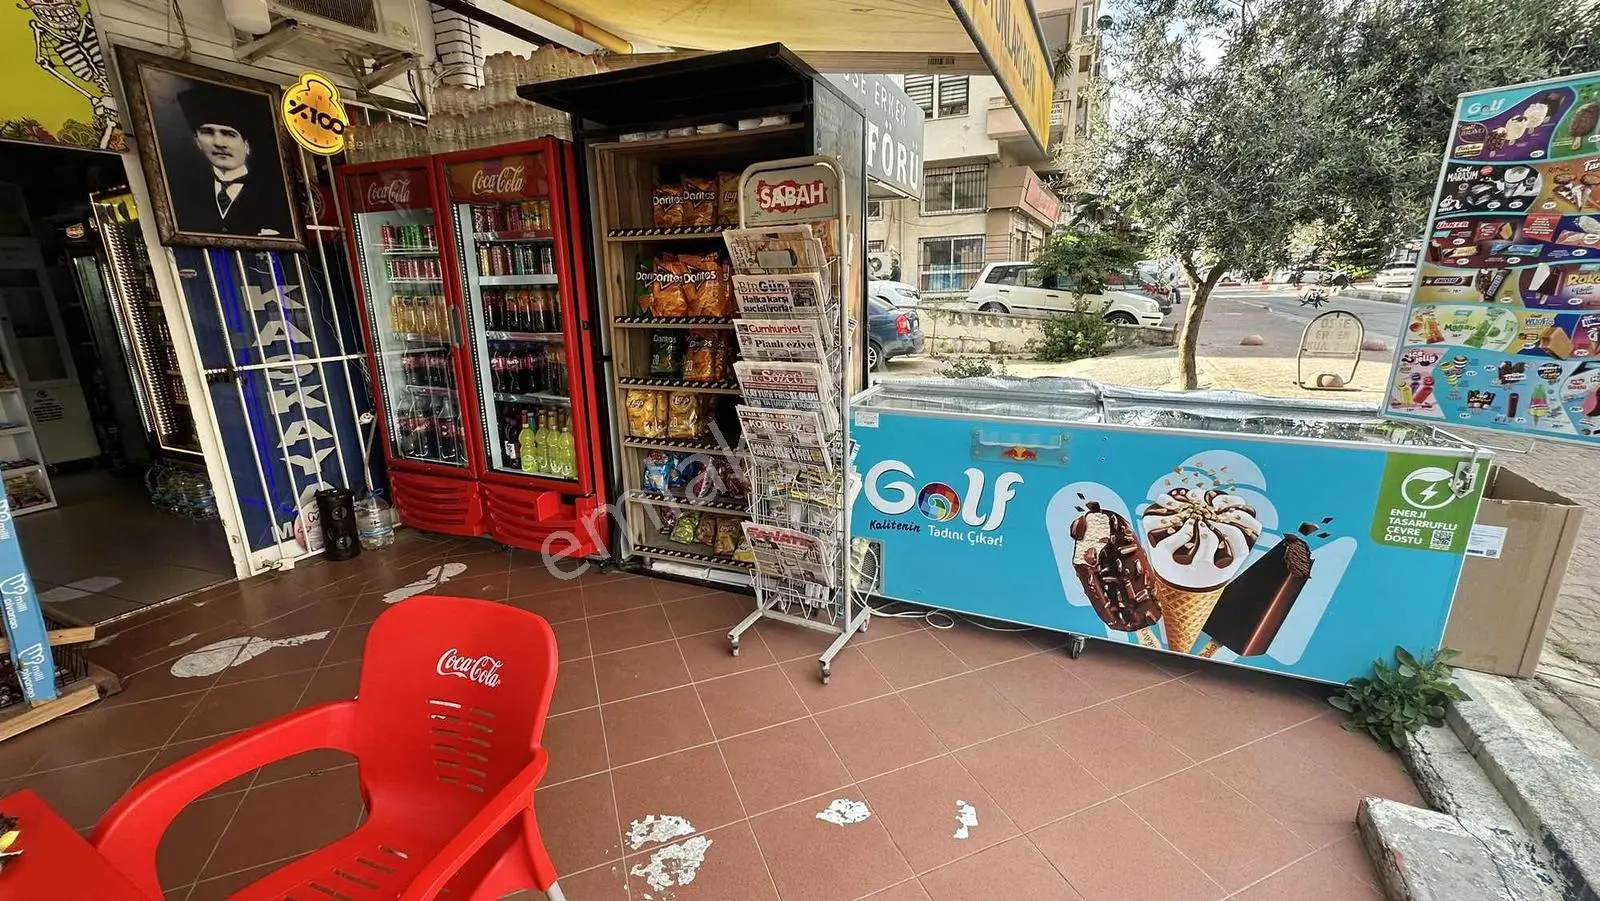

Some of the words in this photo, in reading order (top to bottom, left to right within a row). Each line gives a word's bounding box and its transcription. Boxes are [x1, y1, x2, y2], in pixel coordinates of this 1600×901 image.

[875, 81, 907, 128] ERKEK
[472, 164, 525, 196] Coca-Cola
[368, 178, 411, 205] Coca-Cola
[684, 191, 715, 201] Doritos
[760, 183, 825, 209] SABAH
[684, 270, 717, 283] Doritos
[749, 324, 802, 333] Cumhuriyet
[755, 340, 784, 348] Planlı
[749, 419, 804, 432] KORKUSUZ
[864, 459, 1025, 531] Golf
[1390, 508, 1427, 519] ENERJİ
[1388, 517, 1458, 531] TASARRUFLU
[869, 519, 921, 533] Kalitenin
[928, 525, 964, 541] Tadını
[967, 531, 1004, 547] Çıkar!
[1386, 526, 1421, 536] ÇEVRE
[1384, 534, 1423, 545] DOSTU
[436, 647, 504, 688] Coca-Cola
